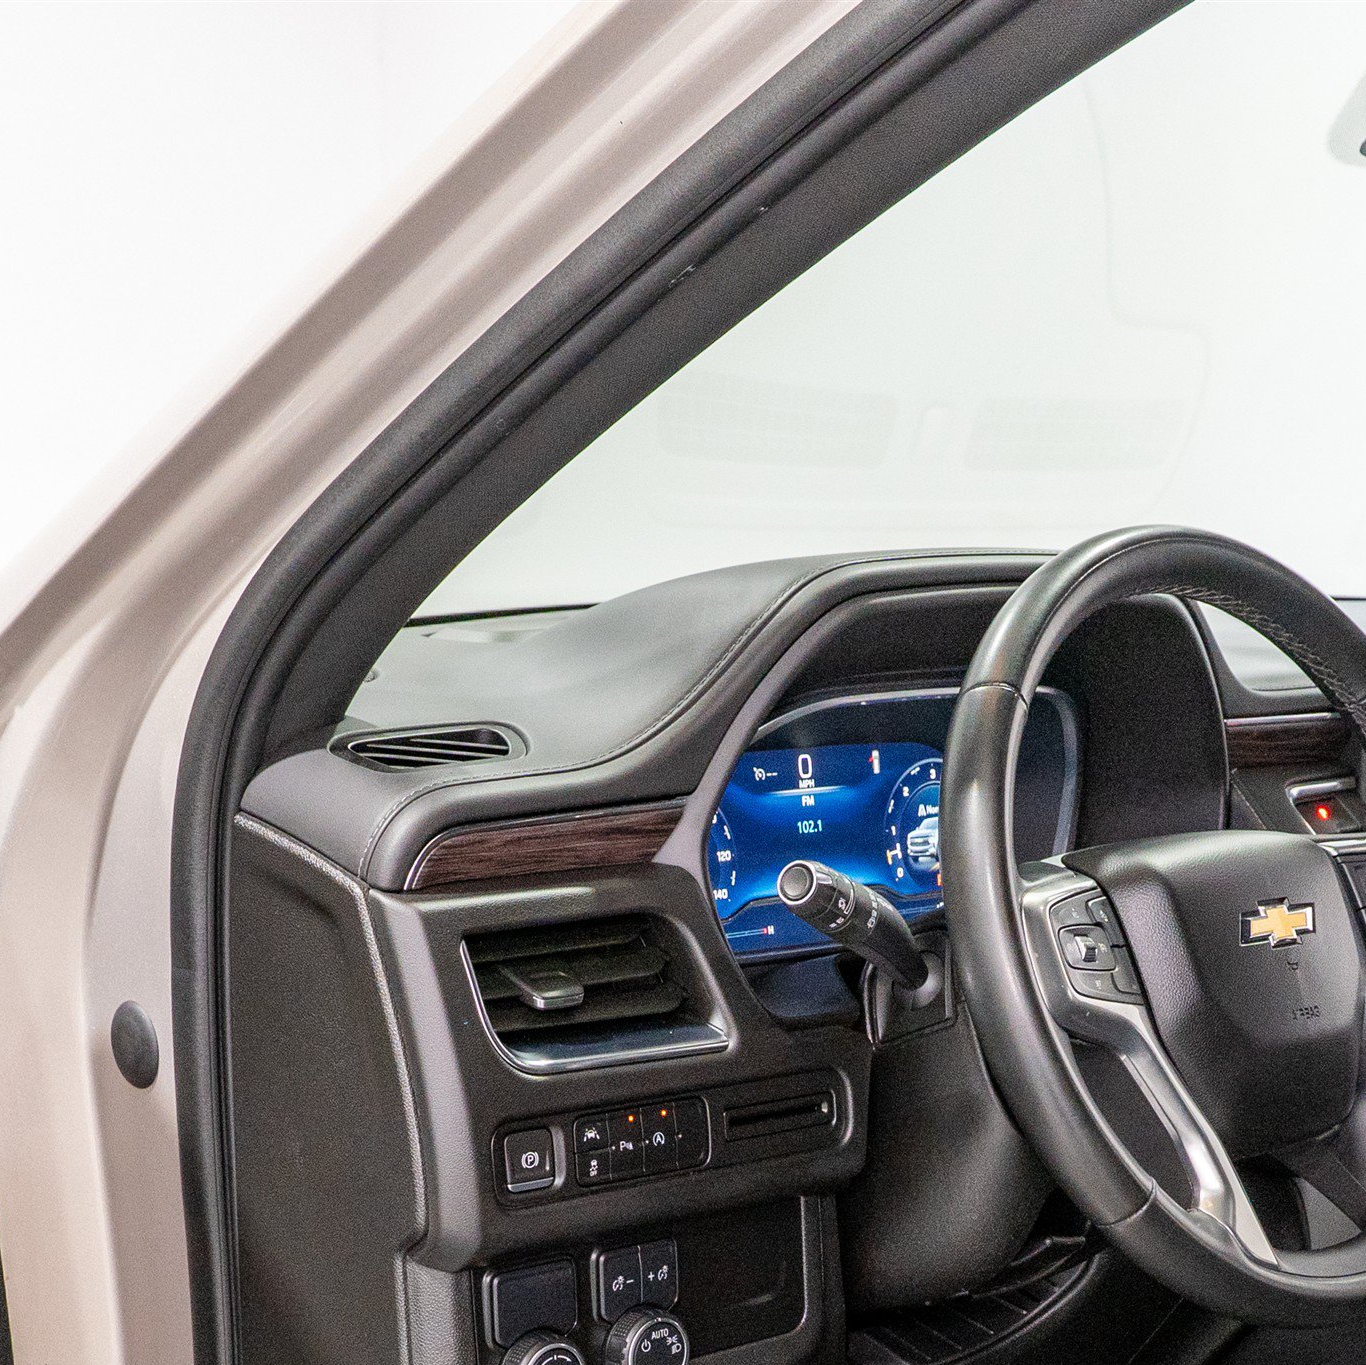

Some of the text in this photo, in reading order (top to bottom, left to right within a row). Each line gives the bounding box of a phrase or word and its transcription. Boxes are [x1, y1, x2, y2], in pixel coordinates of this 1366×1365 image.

[797, 753, 813, 779] 0
[798, 778, 816, 789] MPH
[902, 785, 910, 797] 2
[801, 794, 816, 807] FM
[796, 819, 823, 834] 102.1
[716, 849, 732, 862] 120
[896, 867, 905, 878] 0
[712, 888, 729, 900] 140
[767, 925, 775, 935] H
[651, 1327, 670, 1341] AUTO
